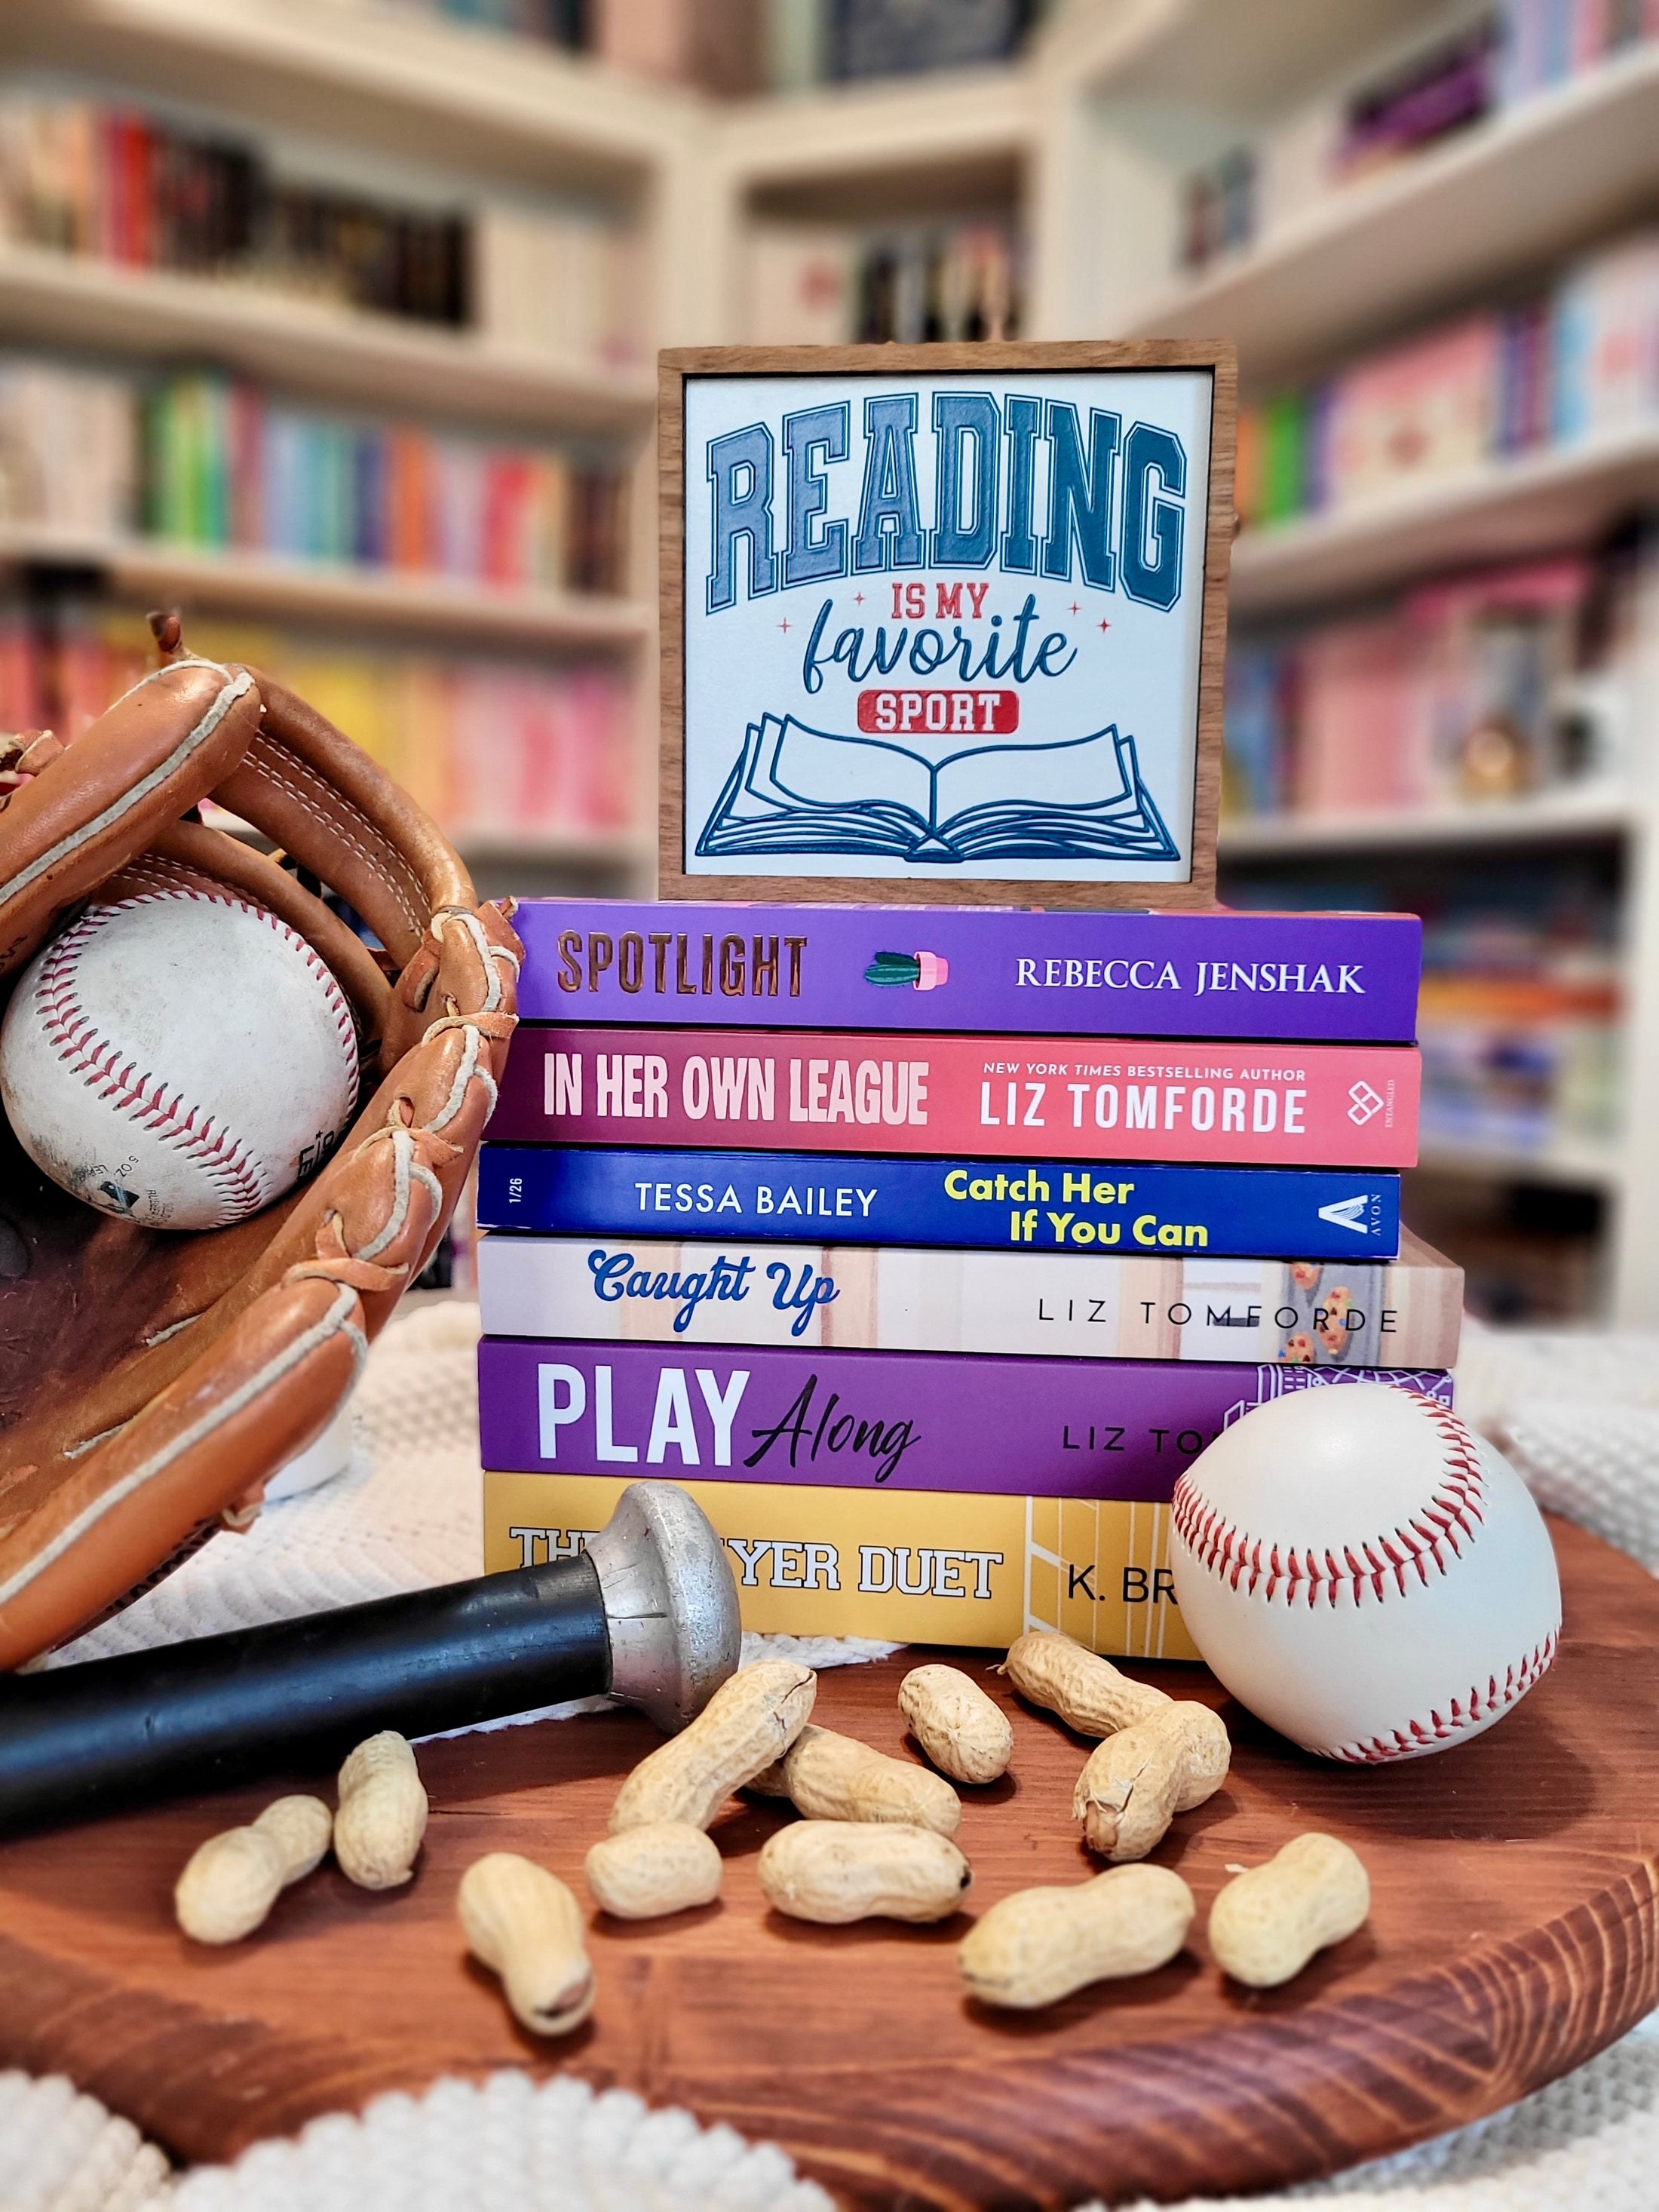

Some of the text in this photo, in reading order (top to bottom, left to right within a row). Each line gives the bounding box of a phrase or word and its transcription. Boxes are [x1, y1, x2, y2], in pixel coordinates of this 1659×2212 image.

[706, 391, 1187, 615] READING
[892, 582, 989, 618] IS MY
[803, 594, 1078, 695] favorite
[875, 692, 1001, 733] SPORT
[557, 929, 808, 998] SPOTLIGHT
[1015, 958, 1366, 996] REBECCA JENSHAK
[544, 1052, 930, 1126] IN HER OWN LEAGUE
[983, 1062, 1307, 1081] NEW YORK TIMES BESTSELLING AUTHOR
[980, 1081, 1308, 1134] LIZ TOMFORDE
[1385, 1079, 1395, 1128] ENTANGLED
[508, 1177, 523, 1204] 1/26
[634, 1182, 879, 1217] TESSA BAILEY
[944, 1170, 1134, 1204] Catch Her
[1010, 1208, 1209, 1247] If You Can
[1370, 1194, 1382, 1236] AVON
[587, 1249, 841, 1337] Caught Up
[1038, 1298, 1398, 1333] LIZ TOMFORDE
[538, 1363, 922, 1483] PLAY Along
[1062, 1425, 1126, 1452] LIZ
[857, 1545, 1004, 1600] DUET
[1068, 1563, 1106, 1602] K.
